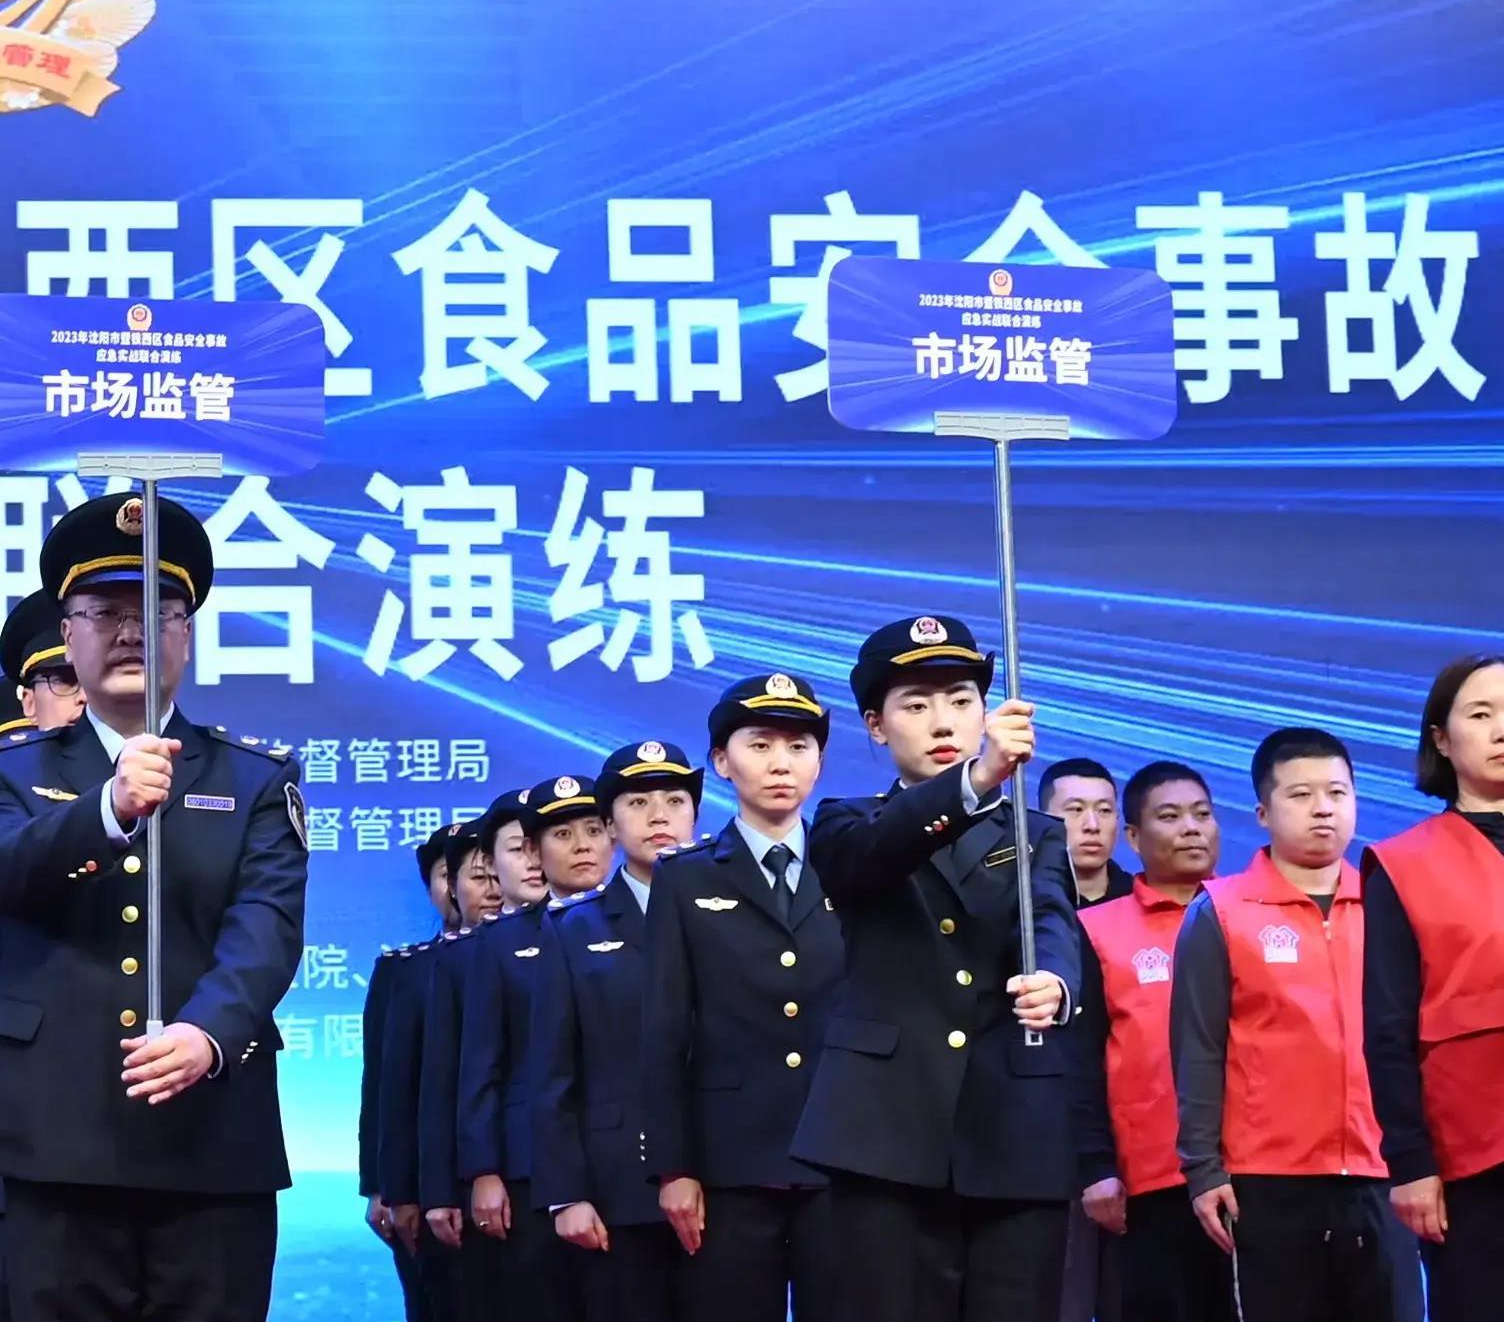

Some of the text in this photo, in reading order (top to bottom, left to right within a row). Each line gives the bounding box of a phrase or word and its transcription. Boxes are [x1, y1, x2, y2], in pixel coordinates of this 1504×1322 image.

[910, 331, 1093, 386] 市场监管
[41, 368, 236, 422] 市场监管
[262, 737, 491, 783] 督管理局
